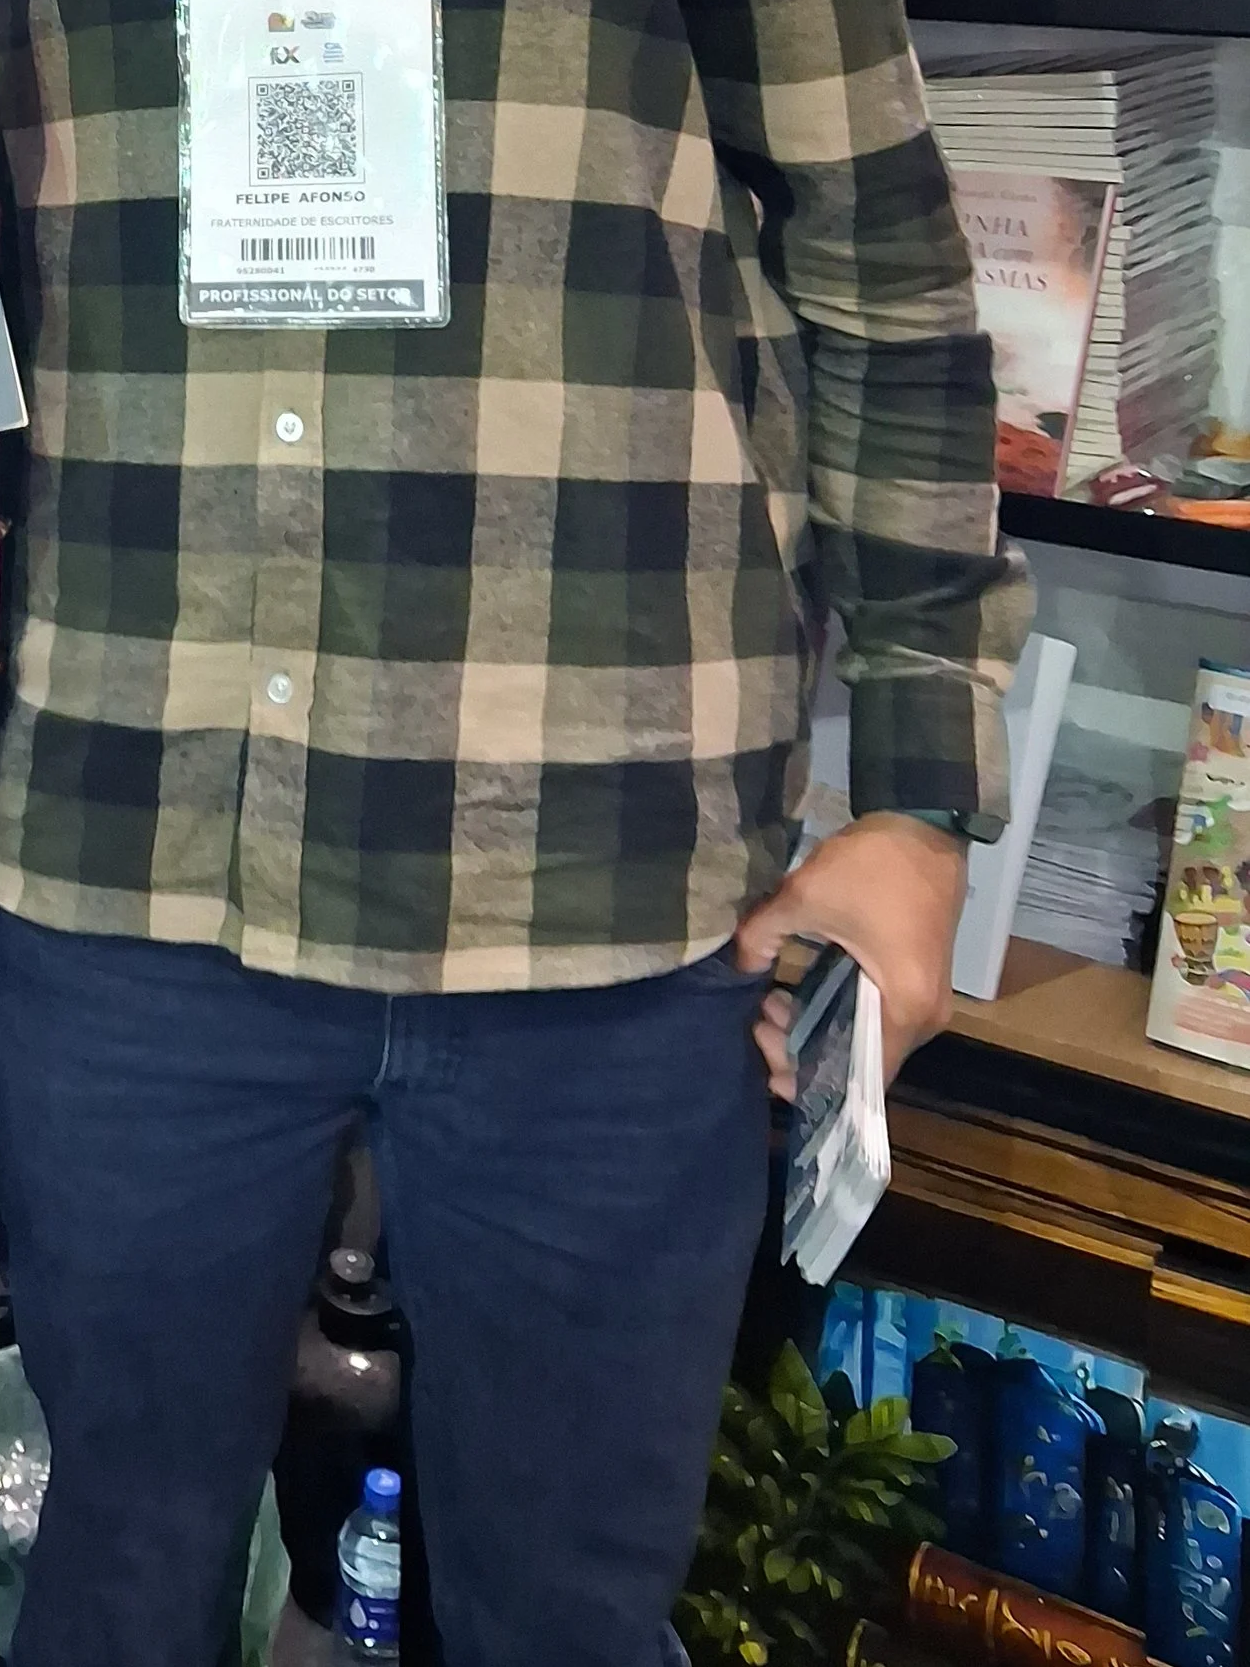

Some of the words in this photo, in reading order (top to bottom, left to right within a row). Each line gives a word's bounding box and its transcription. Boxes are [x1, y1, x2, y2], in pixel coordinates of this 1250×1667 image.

[236, 192, 290, 205] FELIPE
[299, 190, 366, 204] AFONSO
[210, 216, 298, 228] FRATERNIDADE
[301, 216, 317, 227] DE
[320, 214, 395, 226] ESCRITORES
[199, 286, 323, 304] PROFISSIONAL
[327, 287, 353, 302] DO
